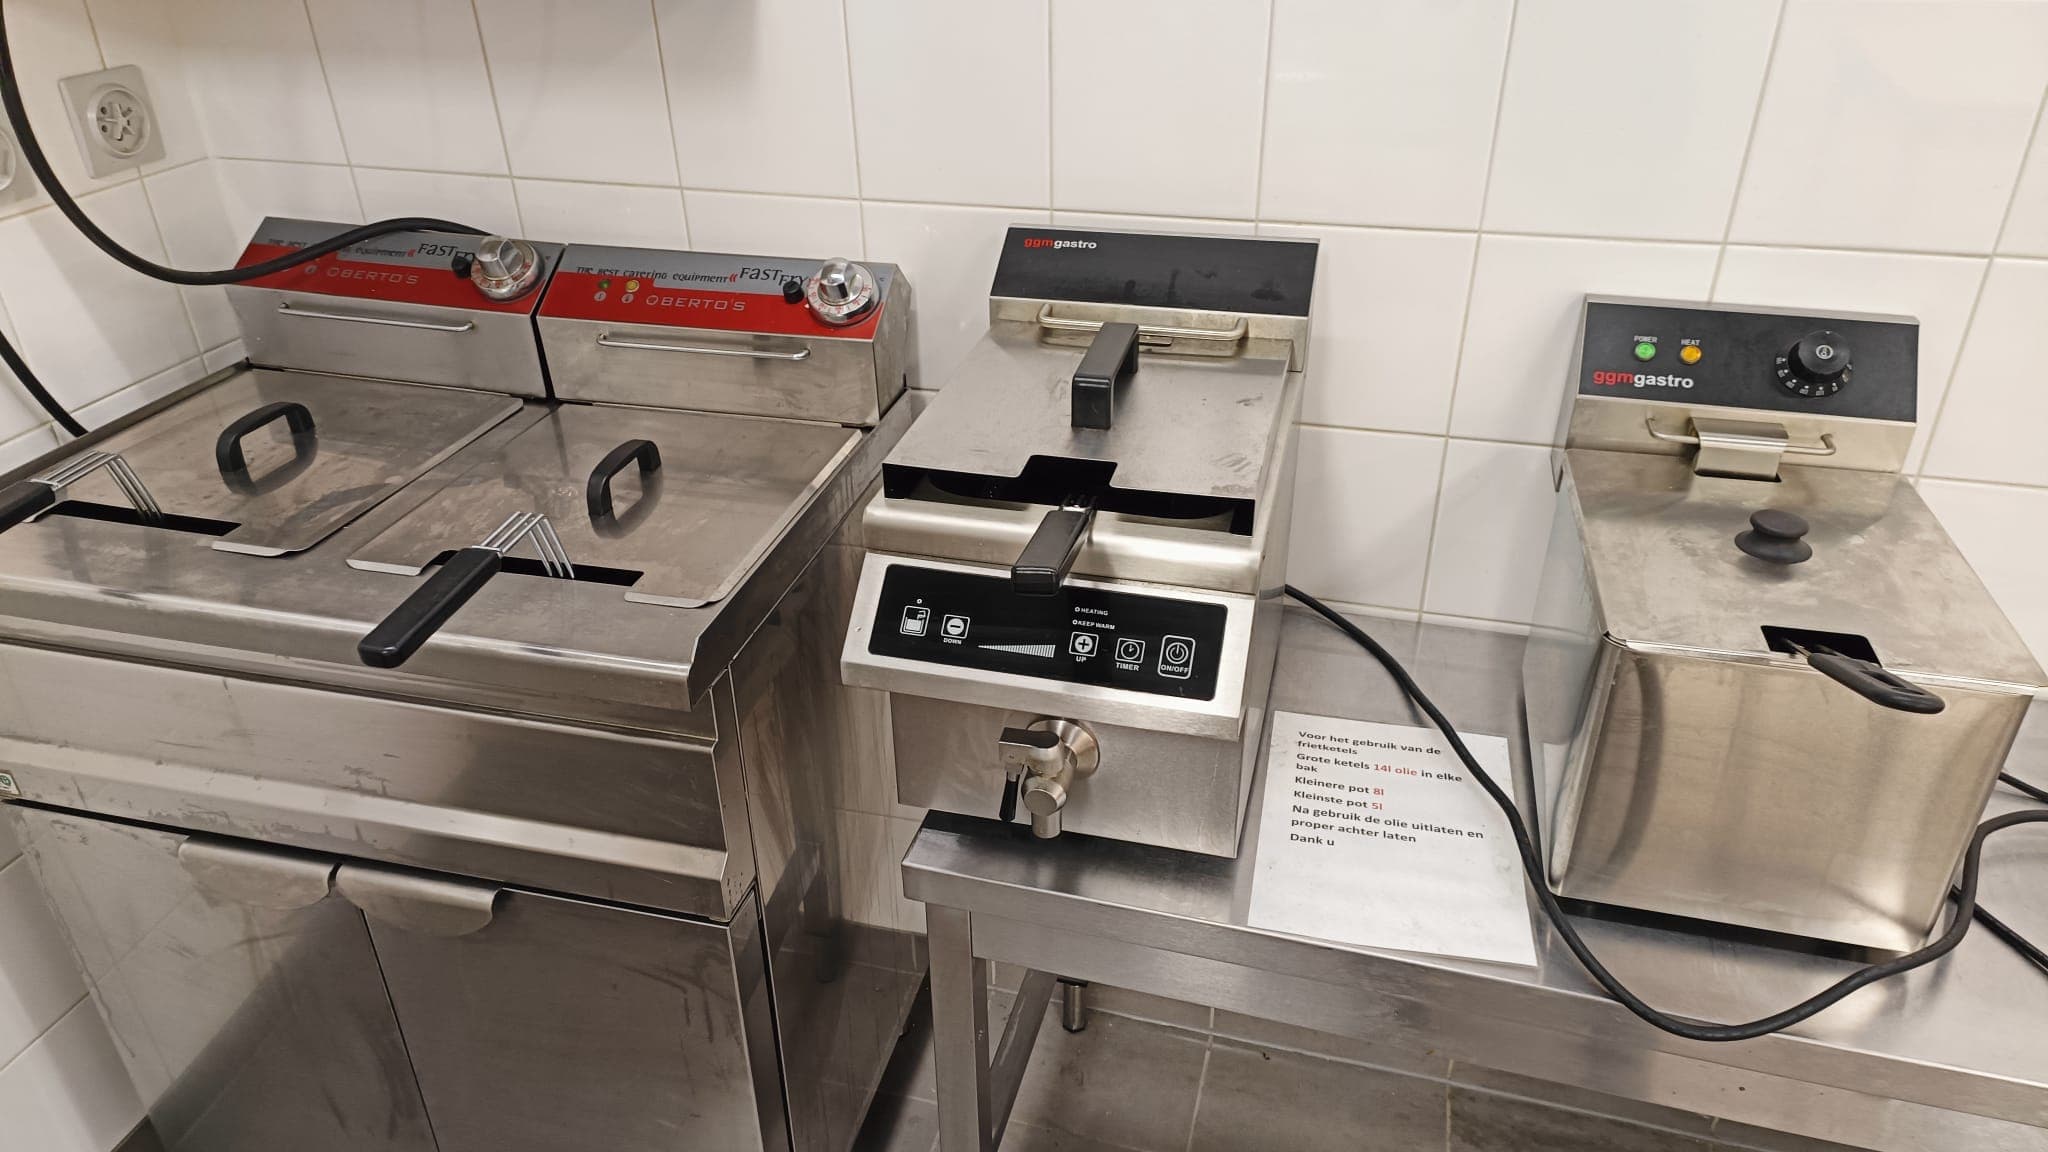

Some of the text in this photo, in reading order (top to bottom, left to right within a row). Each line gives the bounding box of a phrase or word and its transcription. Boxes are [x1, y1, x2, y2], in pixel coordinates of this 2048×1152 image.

[1024, 237, 1097, 249] ggmgastro
[327, 267, 419, 285] OBERTO'S
[646, 294, 746, 311] OBERTO'S
[1634, 335, 1658, 343] POWER
[1680, 338, 1700, 346] HEAT
[1593, 371, 1694, 389] ggmgastro
[1080, 607, 1109, 616] HEATING
[1095, 622, 1115, 630] WARM
[943, 637, 962, 646] DOWN
[1076, 655, 1087, 663] UP
[1115, 662, 1140, 672] TIMER
[1160, 664, 1189, 675] ON/OFF
[1298, 730, 1441, 755] Voor het gebruik van de
[1298, 740, 1358, 755] frietketels
[1296, 753, 1330, 765] Grote
[1334, 758, 1370, 770] ketels
[1396, 766, 1418, 776] olie
[1422, 769, 1432, 778] in
[1436, 771, 1462, 782] elke
[1296, 762, 1318, 773] bak
[1294, 776, 1345, 790] Kleinere
[1348, 783, 1370, 796] pot
[1294, 790, 1343, 804] Kleinste
[1346, 797, 1368, 811] pot
[1292, 804, 1484, 839] Na gebruik de olie uitlaten en
[1291, 818, 1416, 843] proper achter laten
[1290, 833, 1335, 846] Dank u
